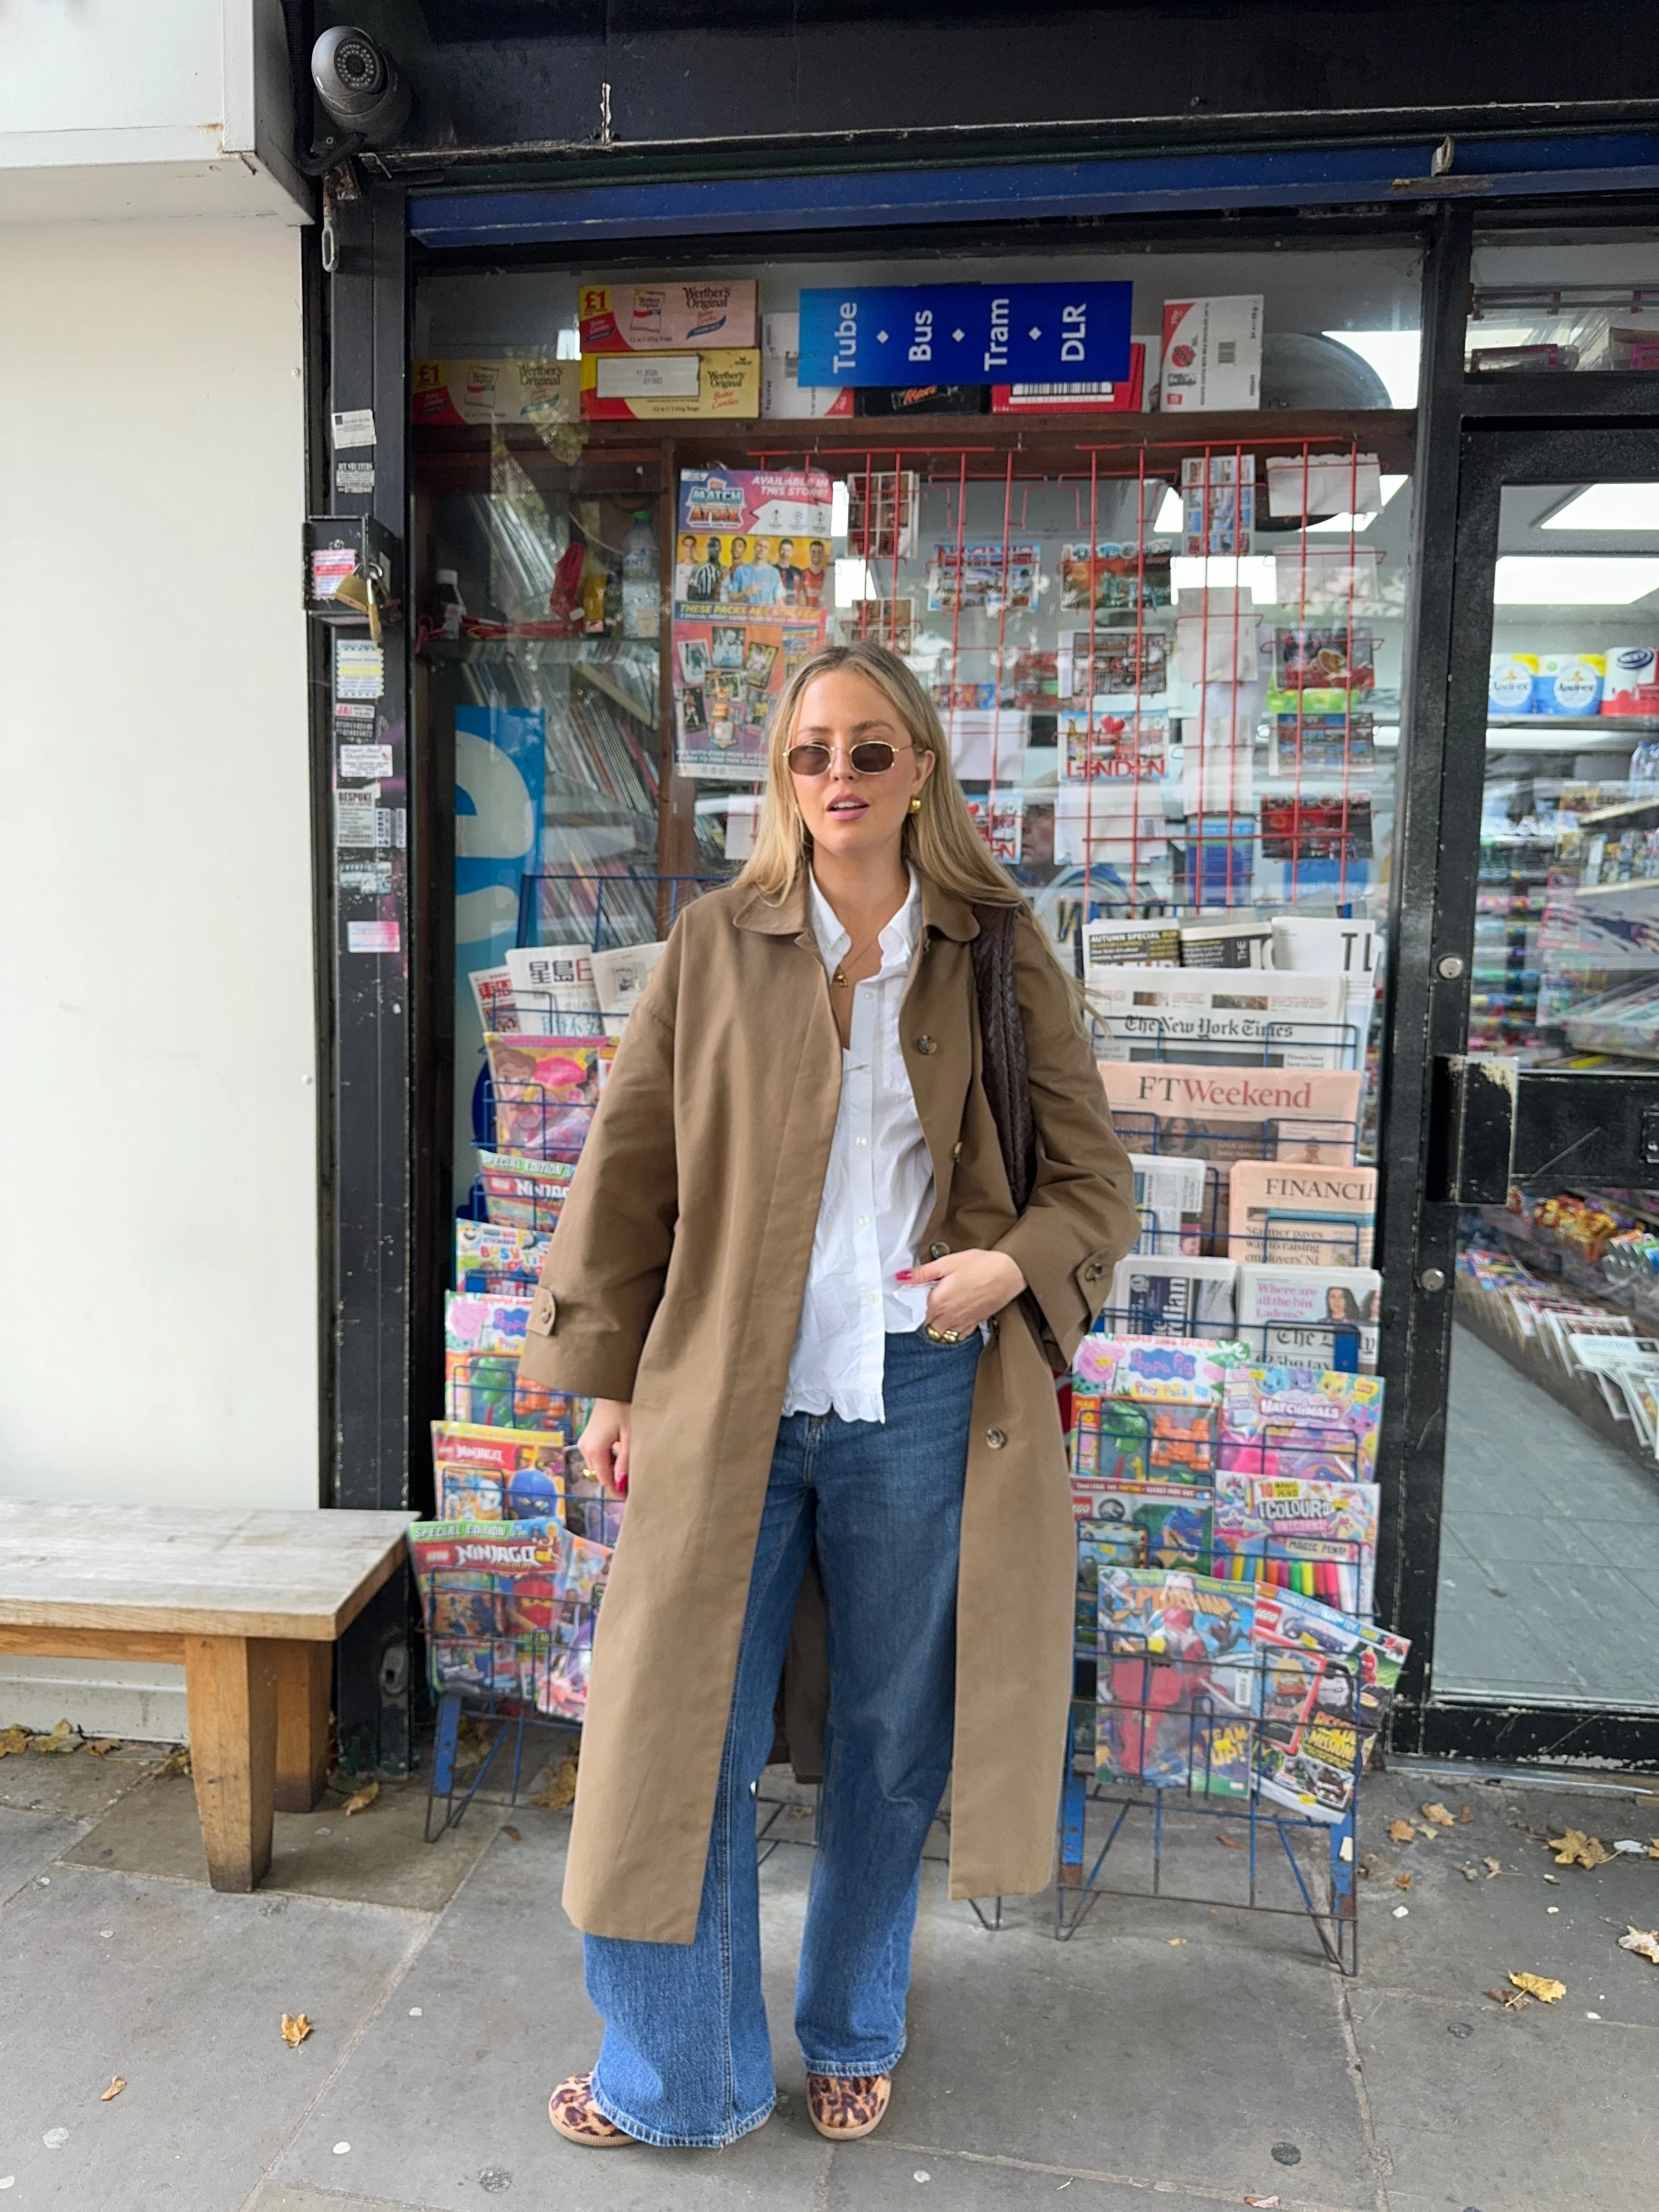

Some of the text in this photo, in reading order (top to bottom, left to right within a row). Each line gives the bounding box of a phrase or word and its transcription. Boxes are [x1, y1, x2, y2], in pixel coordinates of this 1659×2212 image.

[584, 290, 606, 311] £1
[682, 286, 732, 300] Werther's
[686, 298, 728, 309] Original
[833, 302, 857, 374] Tube
[909, 310, 933, 362] Bus
[984, 298, 1009, 371] Tram
[1061, 303, 1087, 362] DLR
[418, 364, 439, 383] £1
[707, 370, 746, 380] Werther's
[709, 378, 743, 388] Original
[752, 475, 813, 487] AVAILABLE
[691, 488, 742, 503] MATCH
[761, 486, 785, 495] THIS
[690, 506, 740, 522] ATTAX
[680, 605, 712, 613] THESE
[1066, 759, 1165, 778] LNDN
[338, 792, 372, 802] BESPOKE
[1090, 933, 1161, 943] AUTUMN SPECIAL
[1125, 1014, 1293, 1040] The New York Times
[1282, 1243, 1320, 1254] raising
[1244, 1253, 1304, 1265] emloyers'
[1257, 1282, 1318, 1297] Where are
[1256, 1295, 1313, 1308] all the bin
[1276, 1329, 1316, 1348] The
[1130, 1349, 1171, 1375] Peppa
[456, 1444, 506, 1465] NINJAGO
[455, 1544, 543, 1567] NINJAGO
[1256, 1608, 1279, 1623] LEGO
